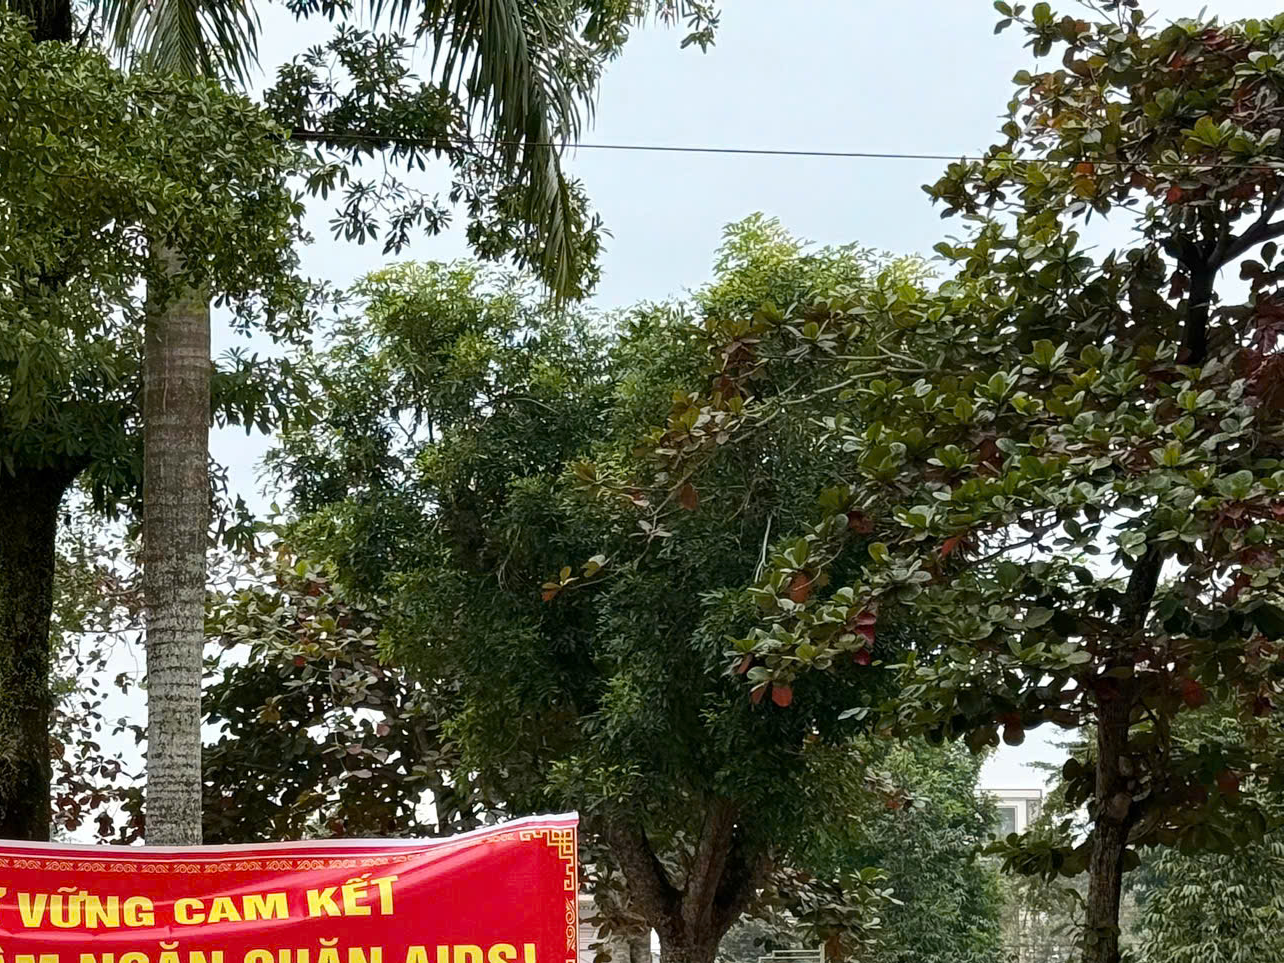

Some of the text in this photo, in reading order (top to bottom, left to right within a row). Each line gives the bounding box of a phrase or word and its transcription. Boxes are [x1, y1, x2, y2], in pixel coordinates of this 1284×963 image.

[17, 886, 155, 929] VỮNG
[173, 892, 289, 925] CAM
[307, 873, 398, 918] KẾT
